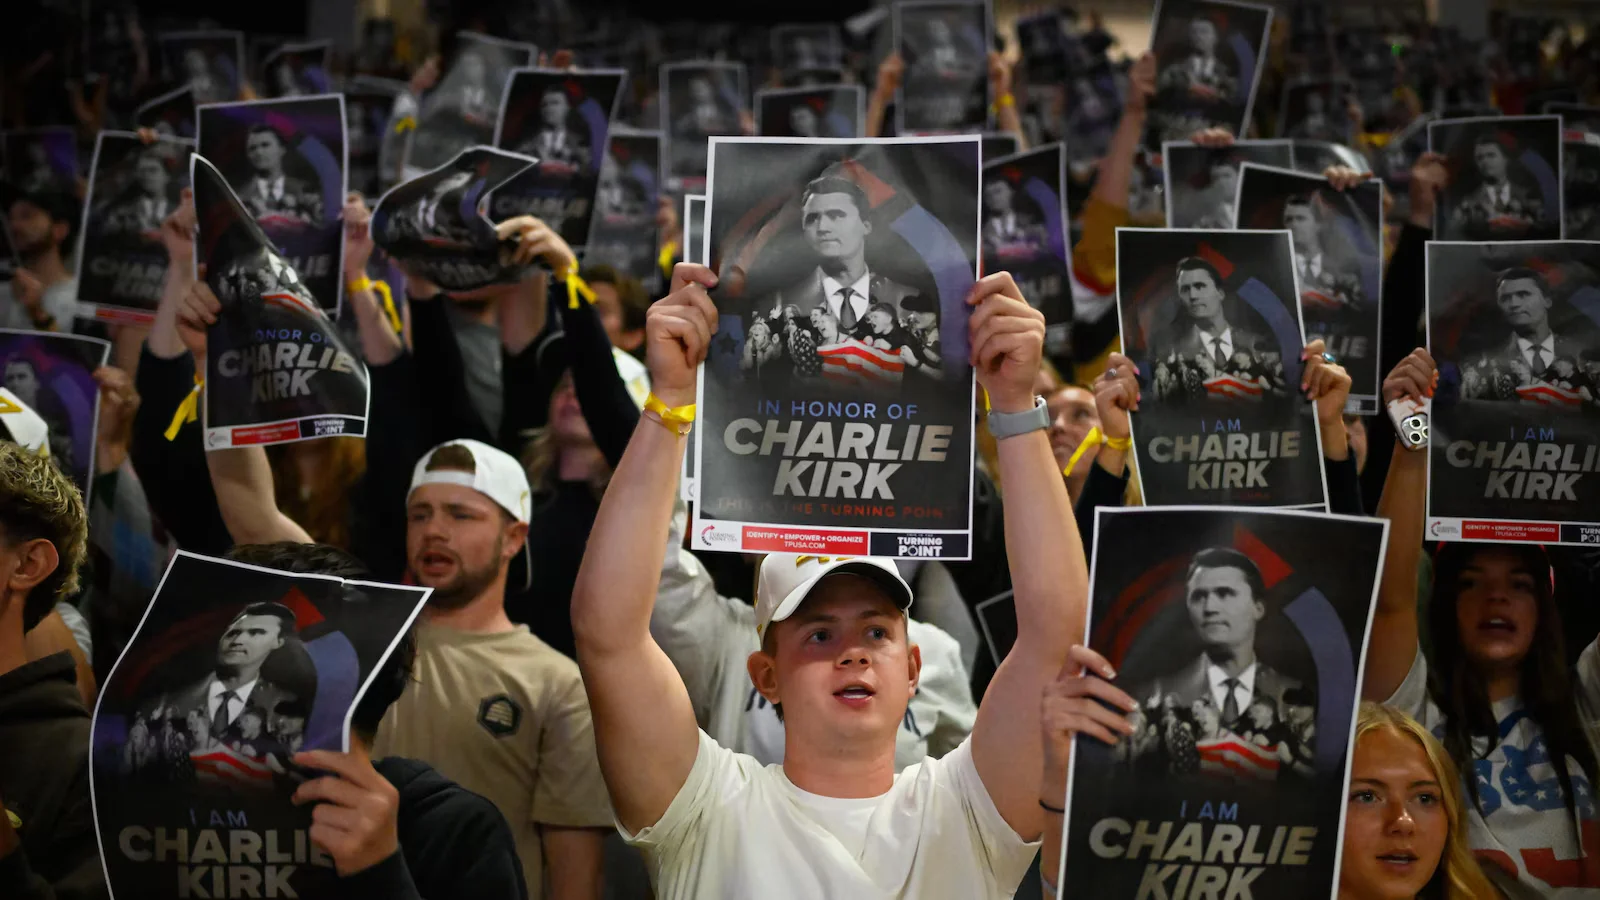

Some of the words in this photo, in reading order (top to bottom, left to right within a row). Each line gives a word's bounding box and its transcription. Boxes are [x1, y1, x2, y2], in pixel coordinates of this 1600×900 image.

[255, 328, 302, 342] ONOR
[217, 341, 356, 378] CHARLIE
[252, 369, 318, 402] KIRK
[757, 400, 780, 416] IN
[791, 401, 876, 418] HONOR
[887, 403, 918, 420] OF
[314, 426, 344, 435] POINT
[1201, 419, 1206, 432] I
[1214, 418, 1241, 431] AM
[1510, 426, 1514, 440] I
[1524, 427, 1555, 441] AM
[723, 417, 954, 462] CHARLIE
[1148, 431, 1301, 463] CHARLIE
[772, 459, 903, 500] KIRK
[1187, 460, 1272, 490] KIRK
[1483, 470, 1583, 501] KIRK
[820, 503, 896, 518] TURNING
[746, 530, 779, 540] IDENTIFY
[784, 532, 820, 541] EMPOWER
[826, 534, 864, 543] ORGANIZE
[784, 541, 825, 549] TPUSA.COM
[897, 536, 943, 546] TURNING
[898, 545, 942, 557] POINT
[190, 808, 196, 826] I
[209, 809, 248, 827] AM
[1180, 799, 1187, 818] I
[1198, 800, 1239, 821] AM
[1088, 816, 1319, 865] CHARLIE
[178, 864, 300, 900] KIRK
[1134, 862, 1267, 900] KIRK
